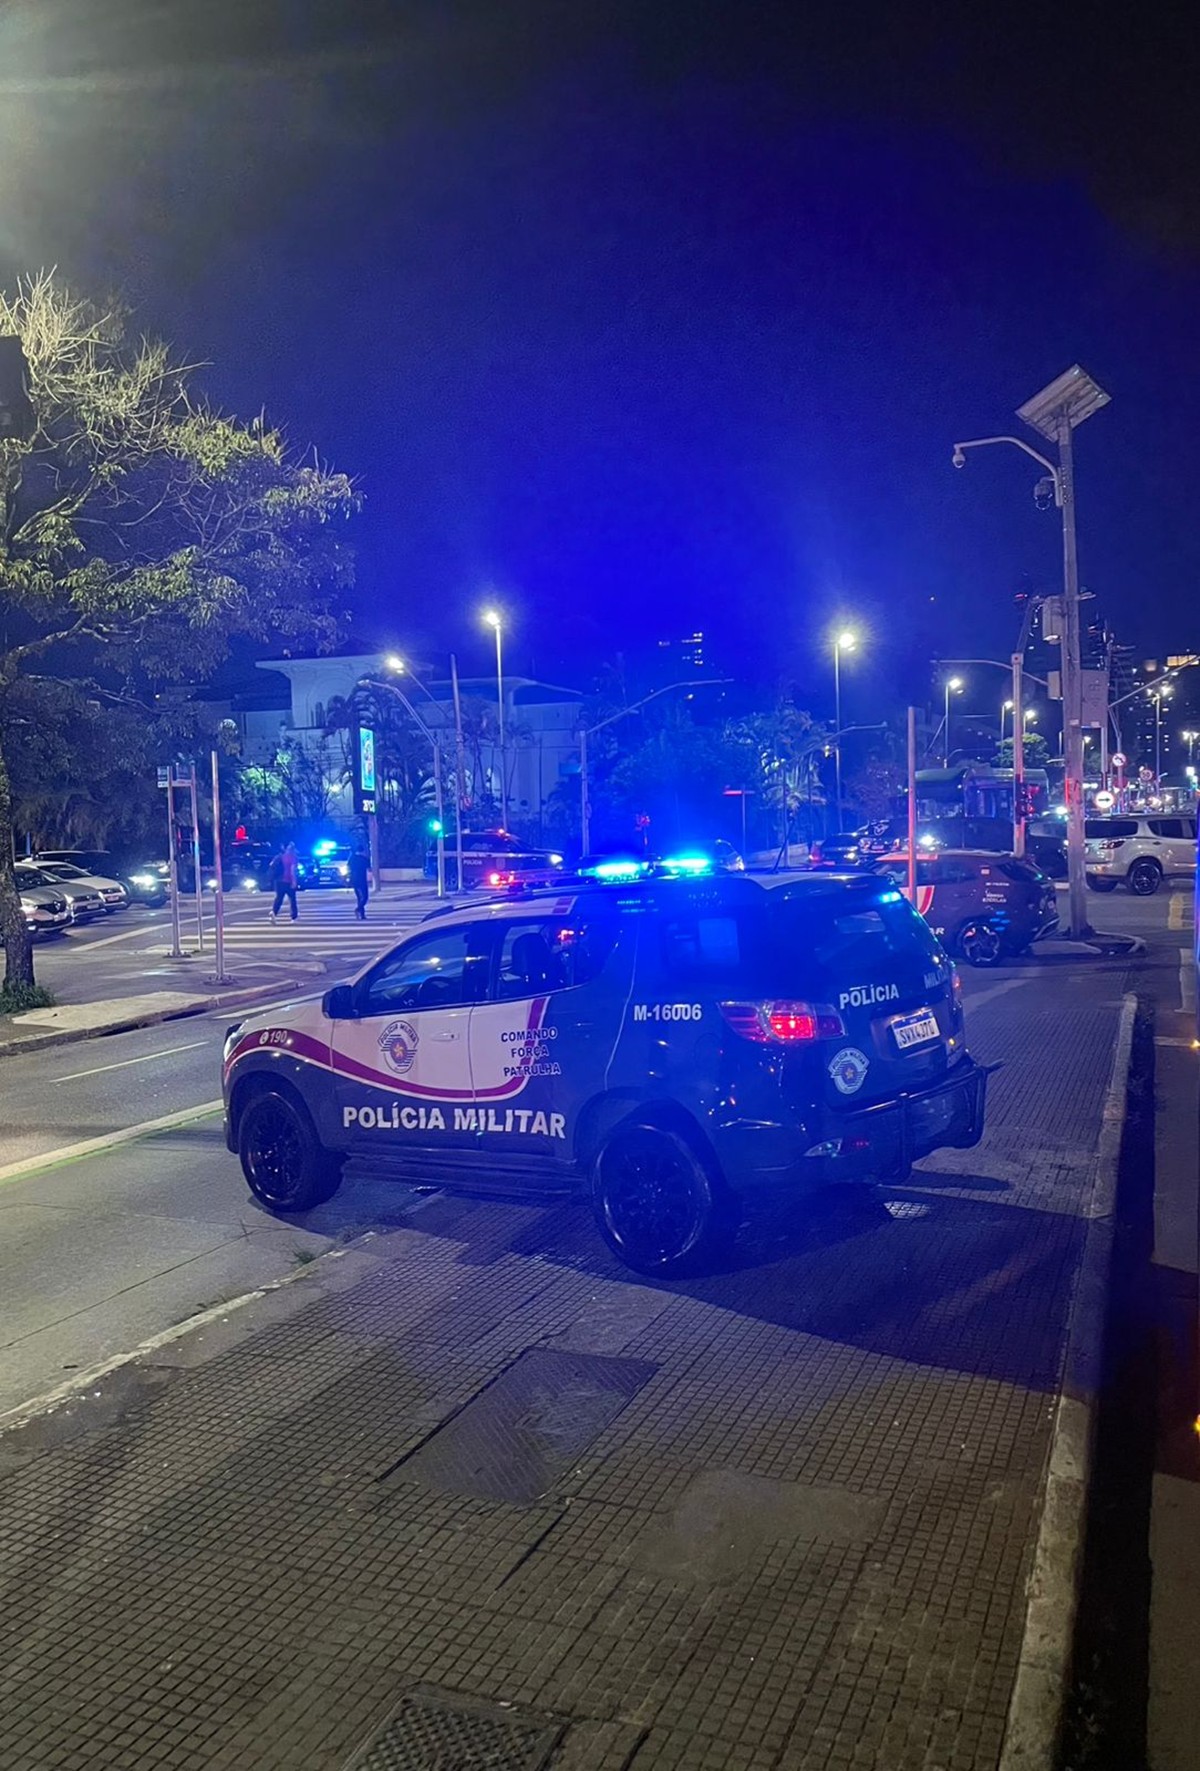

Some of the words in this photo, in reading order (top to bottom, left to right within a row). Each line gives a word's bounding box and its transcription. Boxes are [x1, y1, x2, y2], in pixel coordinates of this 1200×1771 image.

[839, 983, 900, 1009] POLÍCIA
[634, 1003, 702, 1021] M-16006
[270, 1030, 288, 1043] 190
[501, 1026, 558, 1042] COMANDO
[511, 1044, 549, 1060] FORÇA
[503, 1062, 561, 1077] PATRULHA
[343, 1101, 446, 1130] POLÍCIA
[454, 1108, 566, 1139] MILITAR
